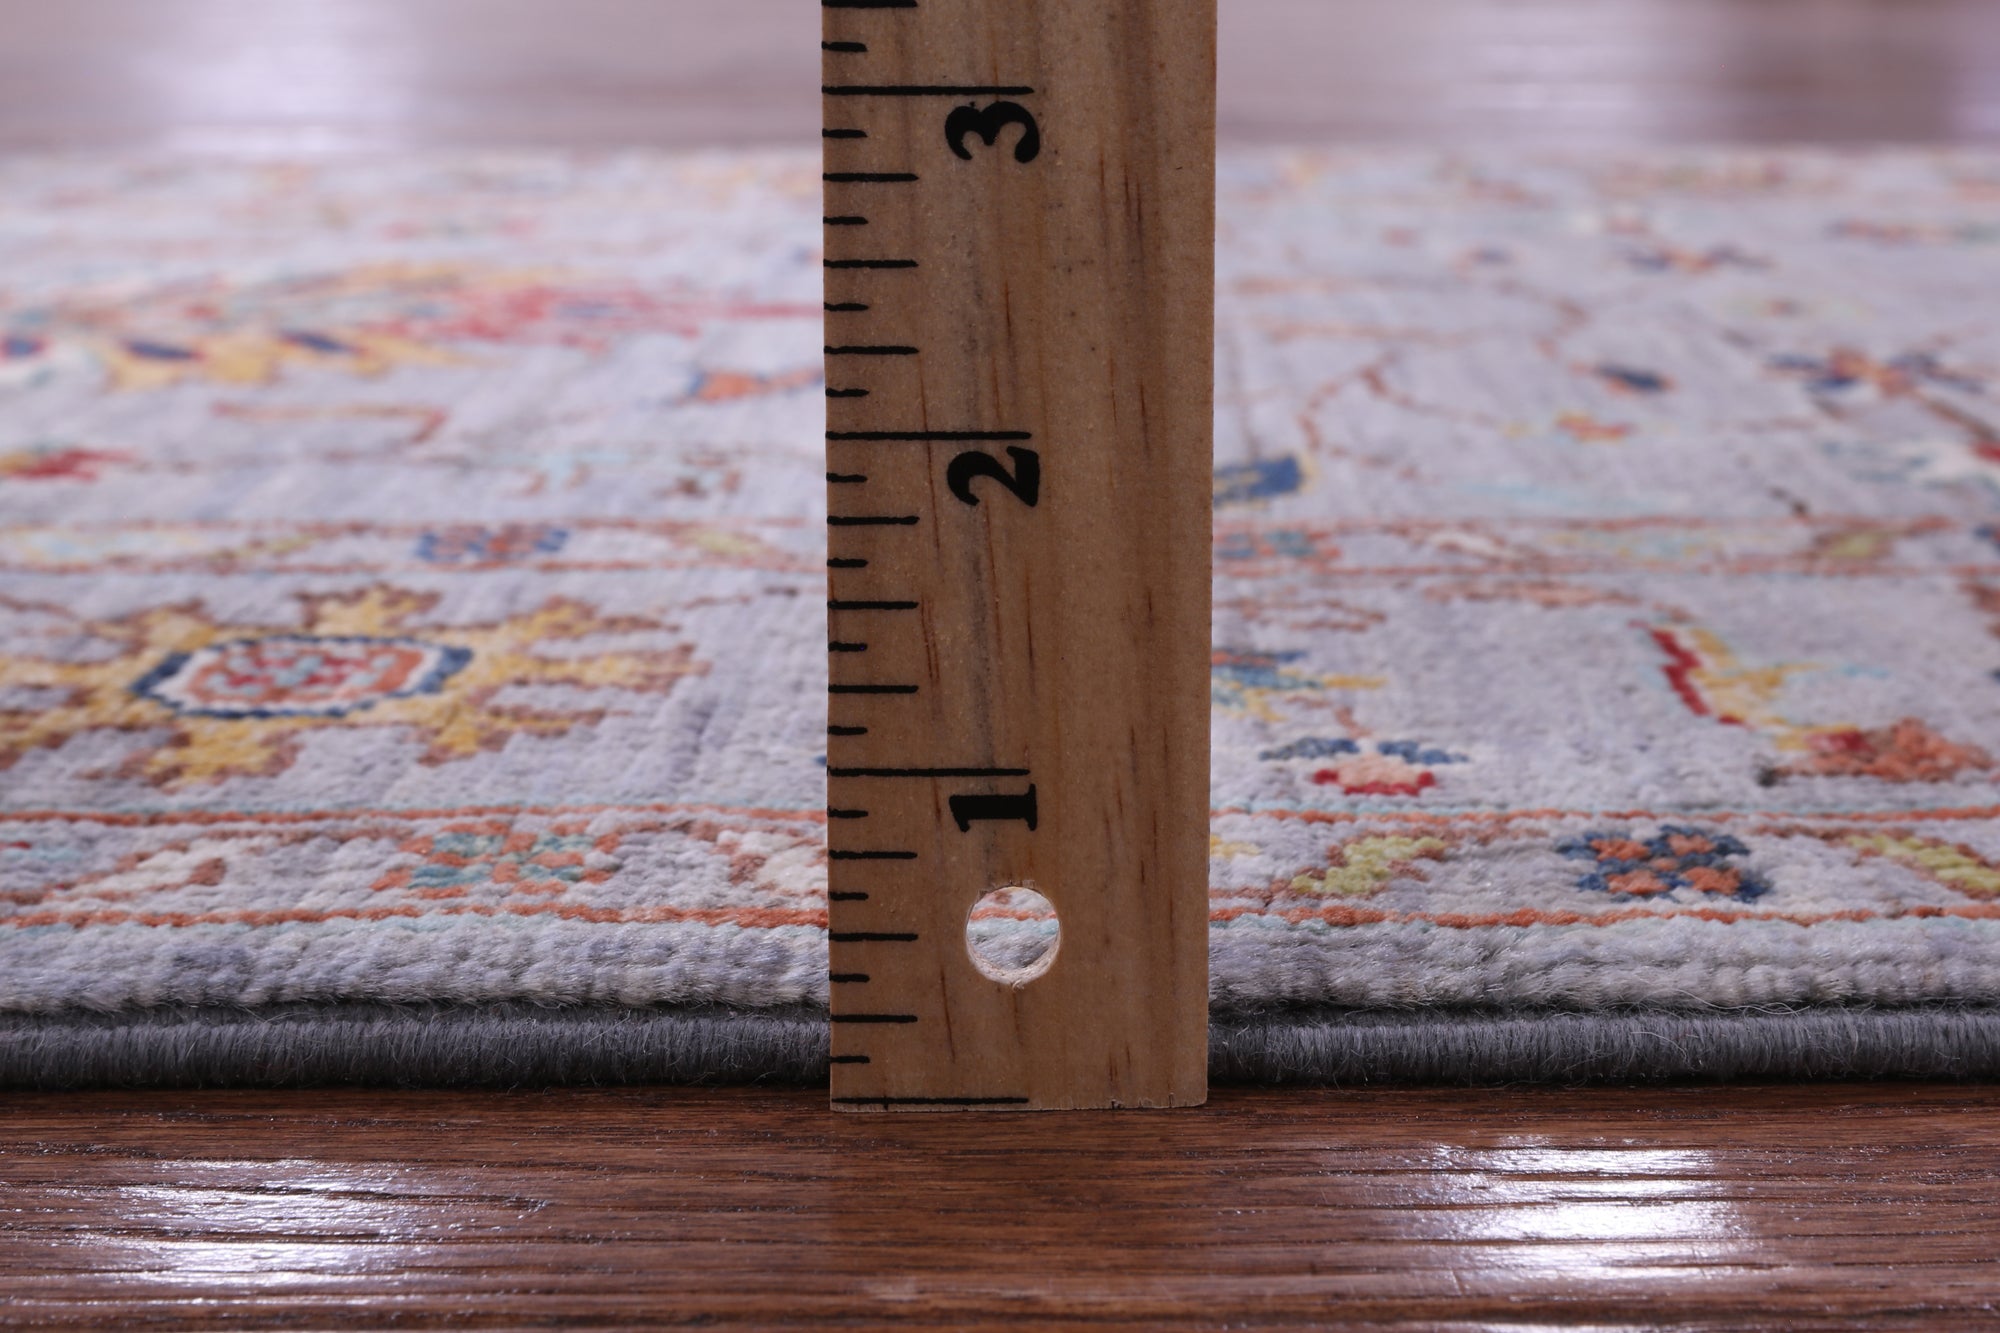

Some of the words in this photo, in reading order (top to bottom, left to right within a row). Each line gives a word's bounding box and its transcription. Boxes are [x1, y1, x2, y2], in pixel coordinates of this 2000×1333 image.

[944, 100, 1041, 164] 3
[946, 445, 1041, 508] 2
[948, 783, 1038, 833] 1
